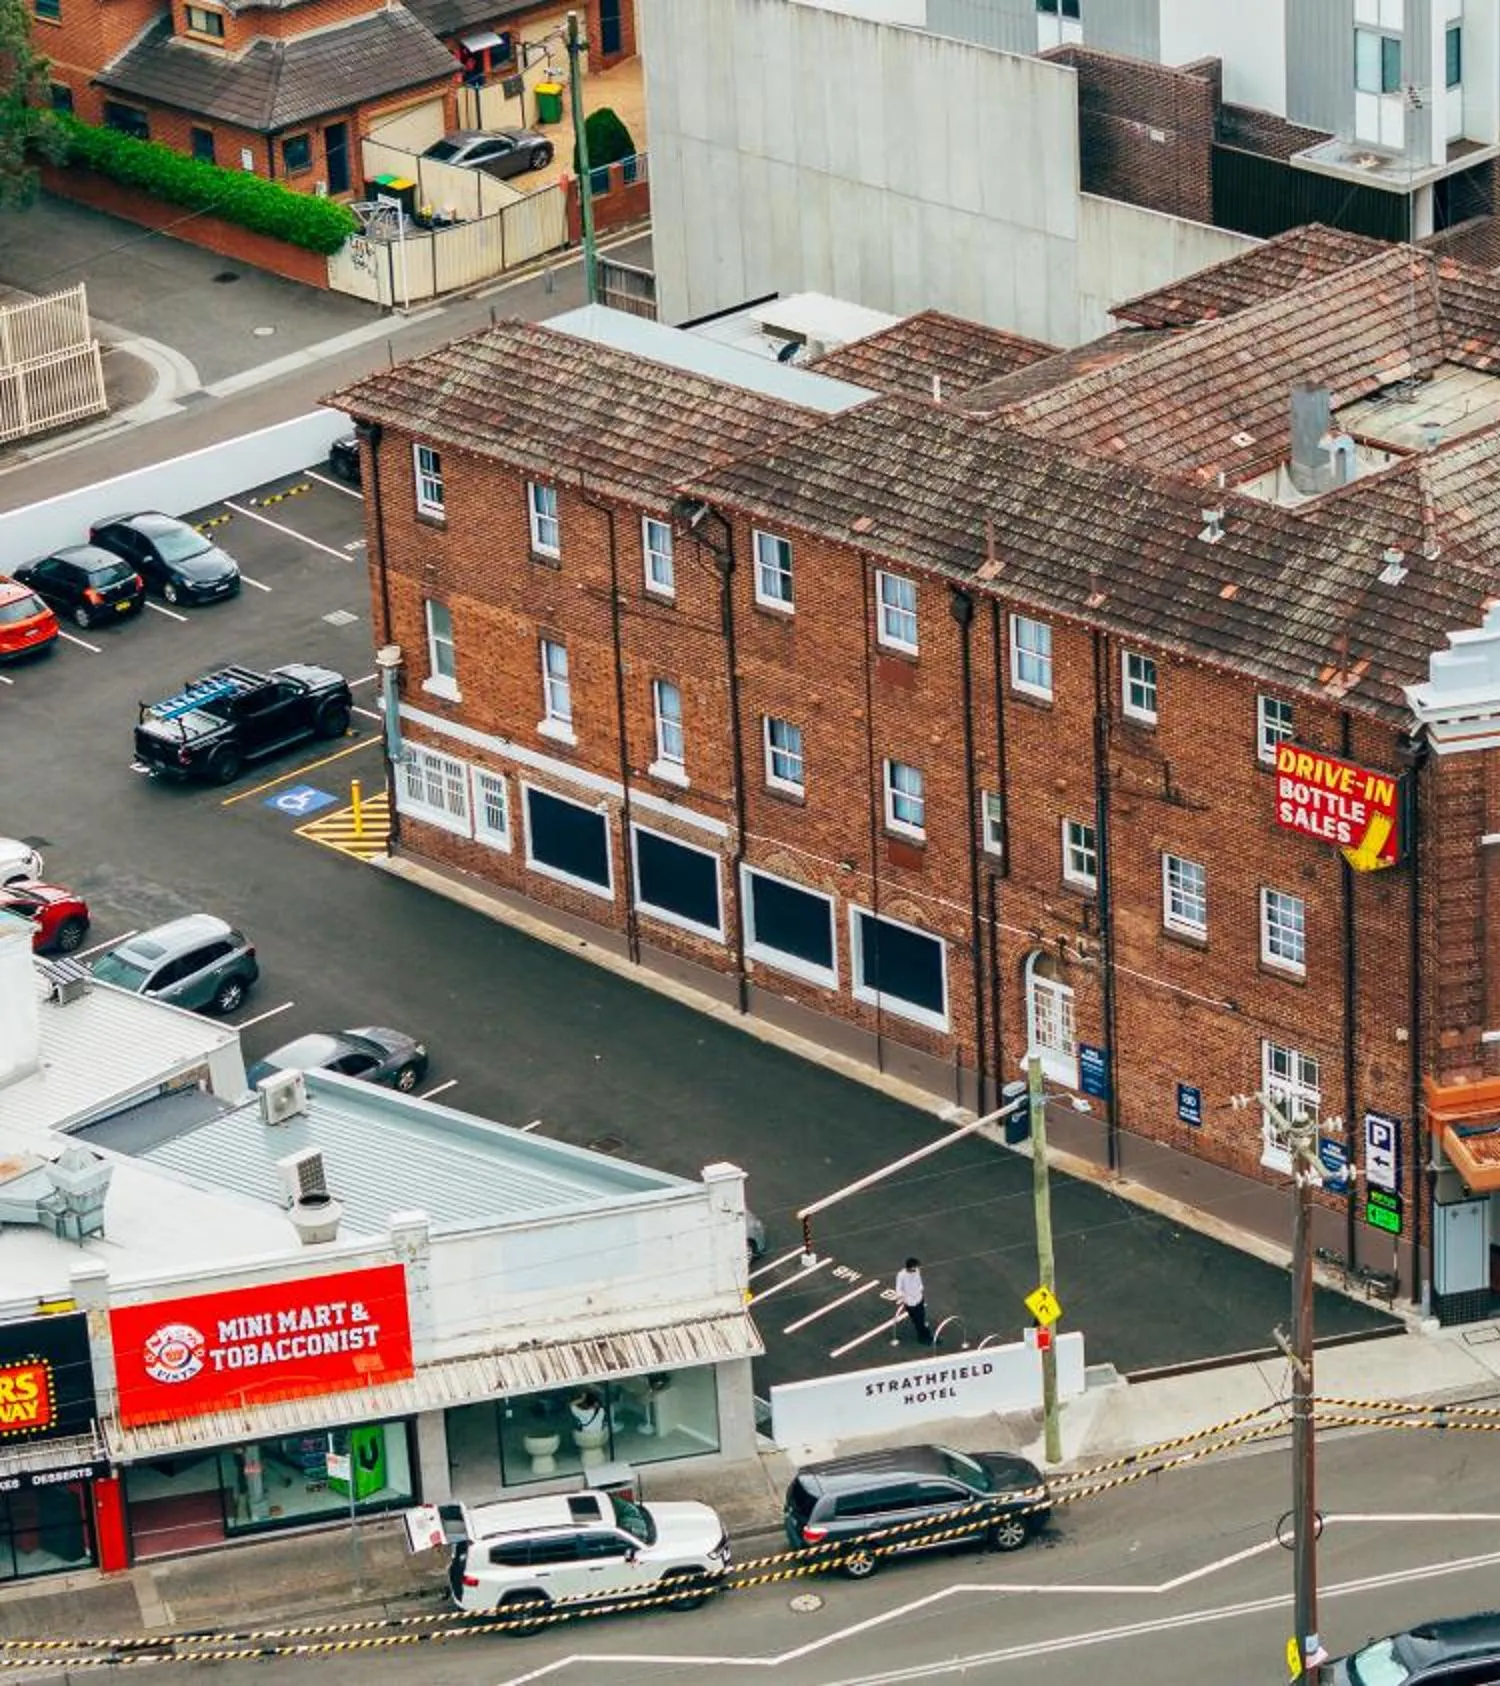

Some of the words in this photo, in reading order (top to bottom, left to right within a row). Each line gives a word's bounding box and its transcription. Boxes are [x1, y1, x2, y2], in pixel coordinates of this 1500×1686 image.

[1278, 747, 1394, 806] DRIVE-IN
[1280, 776, 1365, 824] BOTTLE
[1280, 801, 1351, 843] SALES
[1372, 1124, 1388, 1146] P
[217, 1312, 274, 1343] MINI
[277, 1302, 348, 1333] MART
[351, 1301, 370, 1323] &
[209, 1325, 380, 1371] TOBACCONIST
[865, 1363, 994, 1397] STRATHFIELD
[904, 1387, 957, 1405] HOTEL
[32, 1467, 93, 1486] DESSERTS
